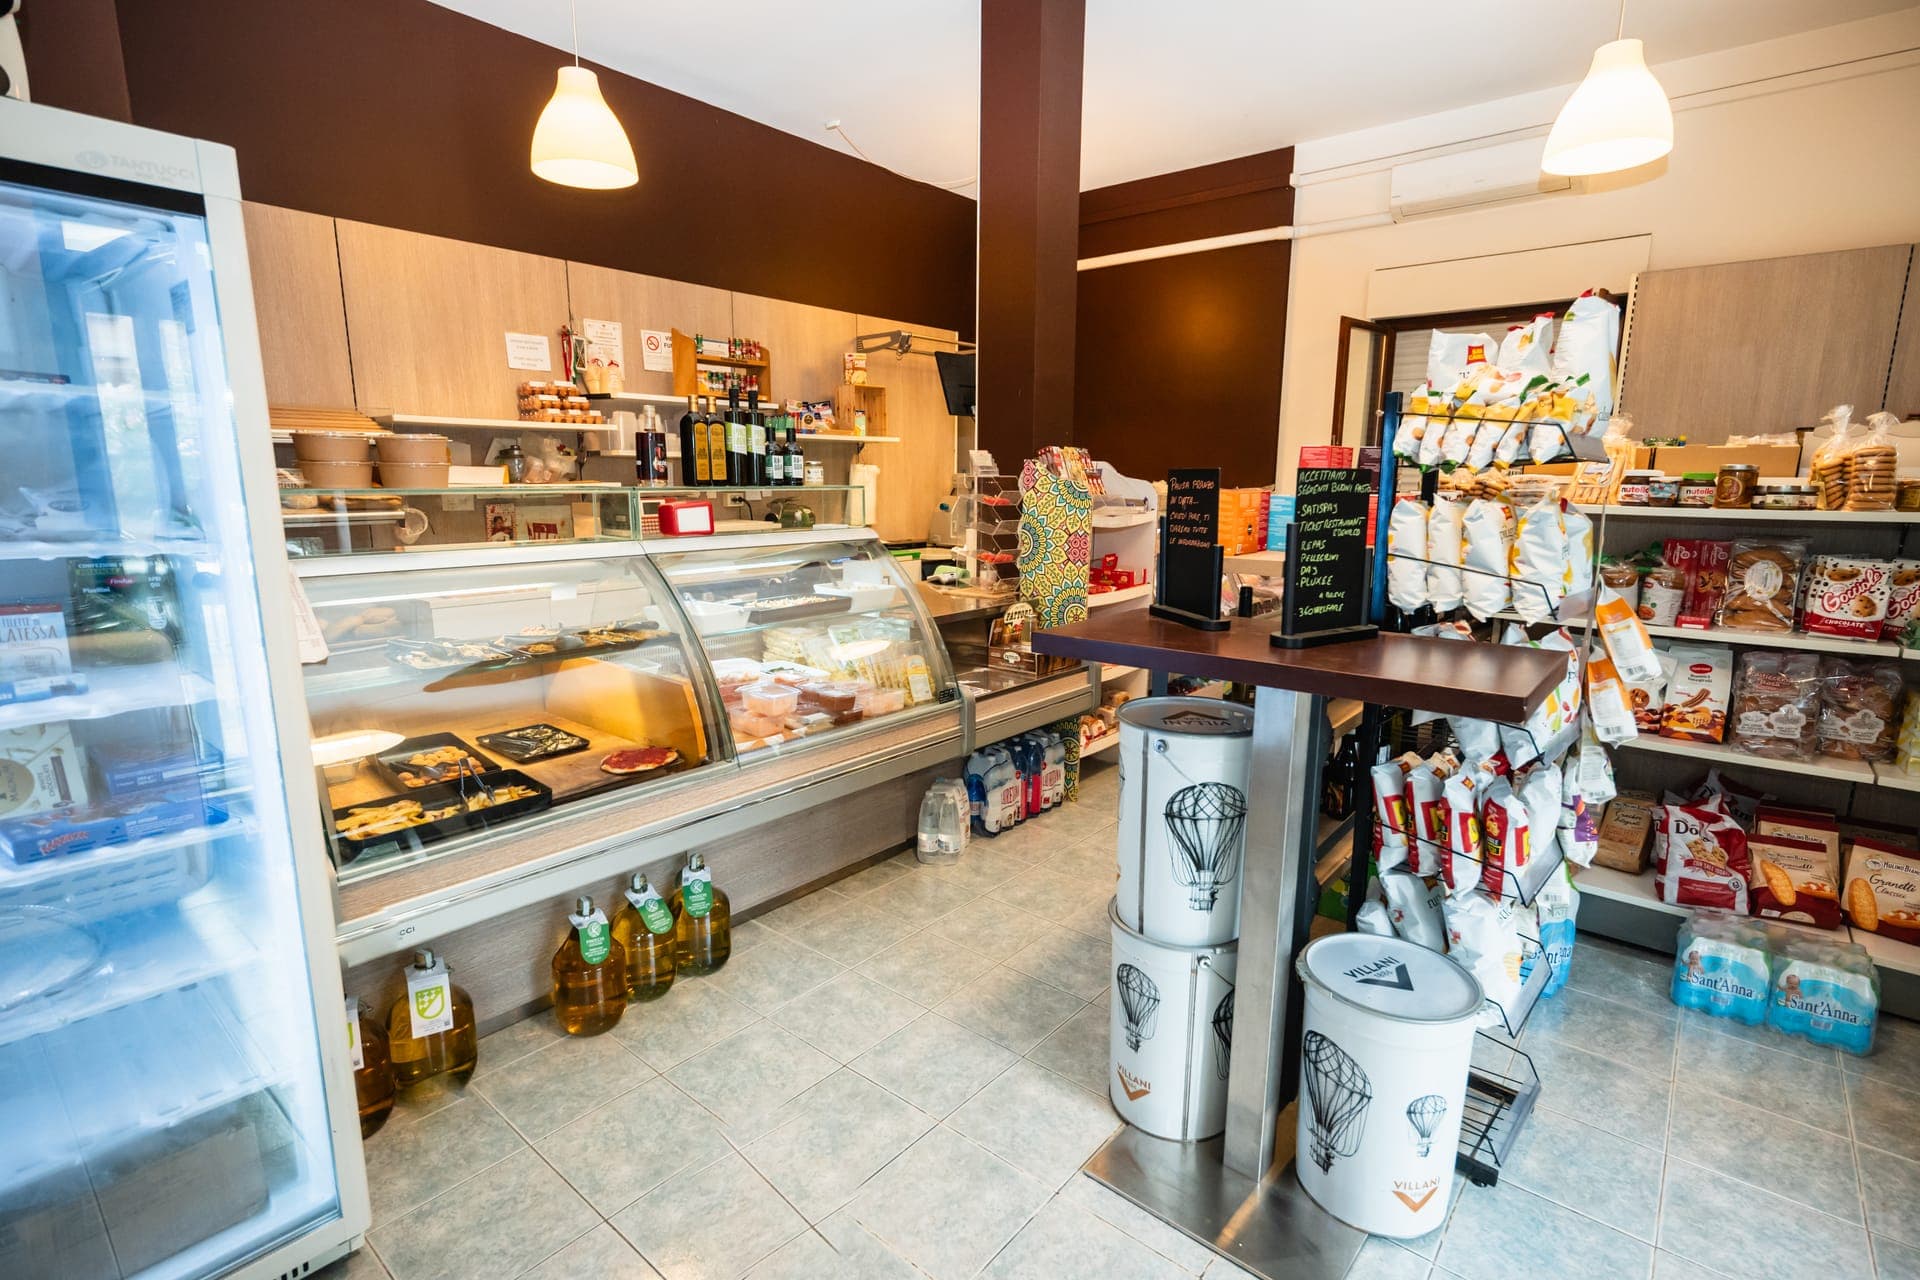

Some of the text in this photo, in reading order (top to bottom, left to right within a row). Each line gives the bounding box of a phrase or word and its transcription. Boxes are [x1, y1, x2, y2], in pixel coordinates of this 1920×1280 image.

[1299, 471, 1346, 482] ACCETTIAMO
[1686, 488, 1714, 496] nutella
[1822, 568, 1882, 613] Gocciole
[1824, 618, 1865, 628] CHOCOLATE
[1883, 861, 1905, 872] MULINO
[1869, 872, 1917, 893] Granetti
[1343, 956, 1400, 978] VILLANI
[1691, 971, 1753, 998] Sant'Anna
[1789, 994, 1857, 1024] Sant'Anna
[1116, 1060, 1151, 1091] VILLANI
[1392, 1176, 1441, 1190] VILLANI
